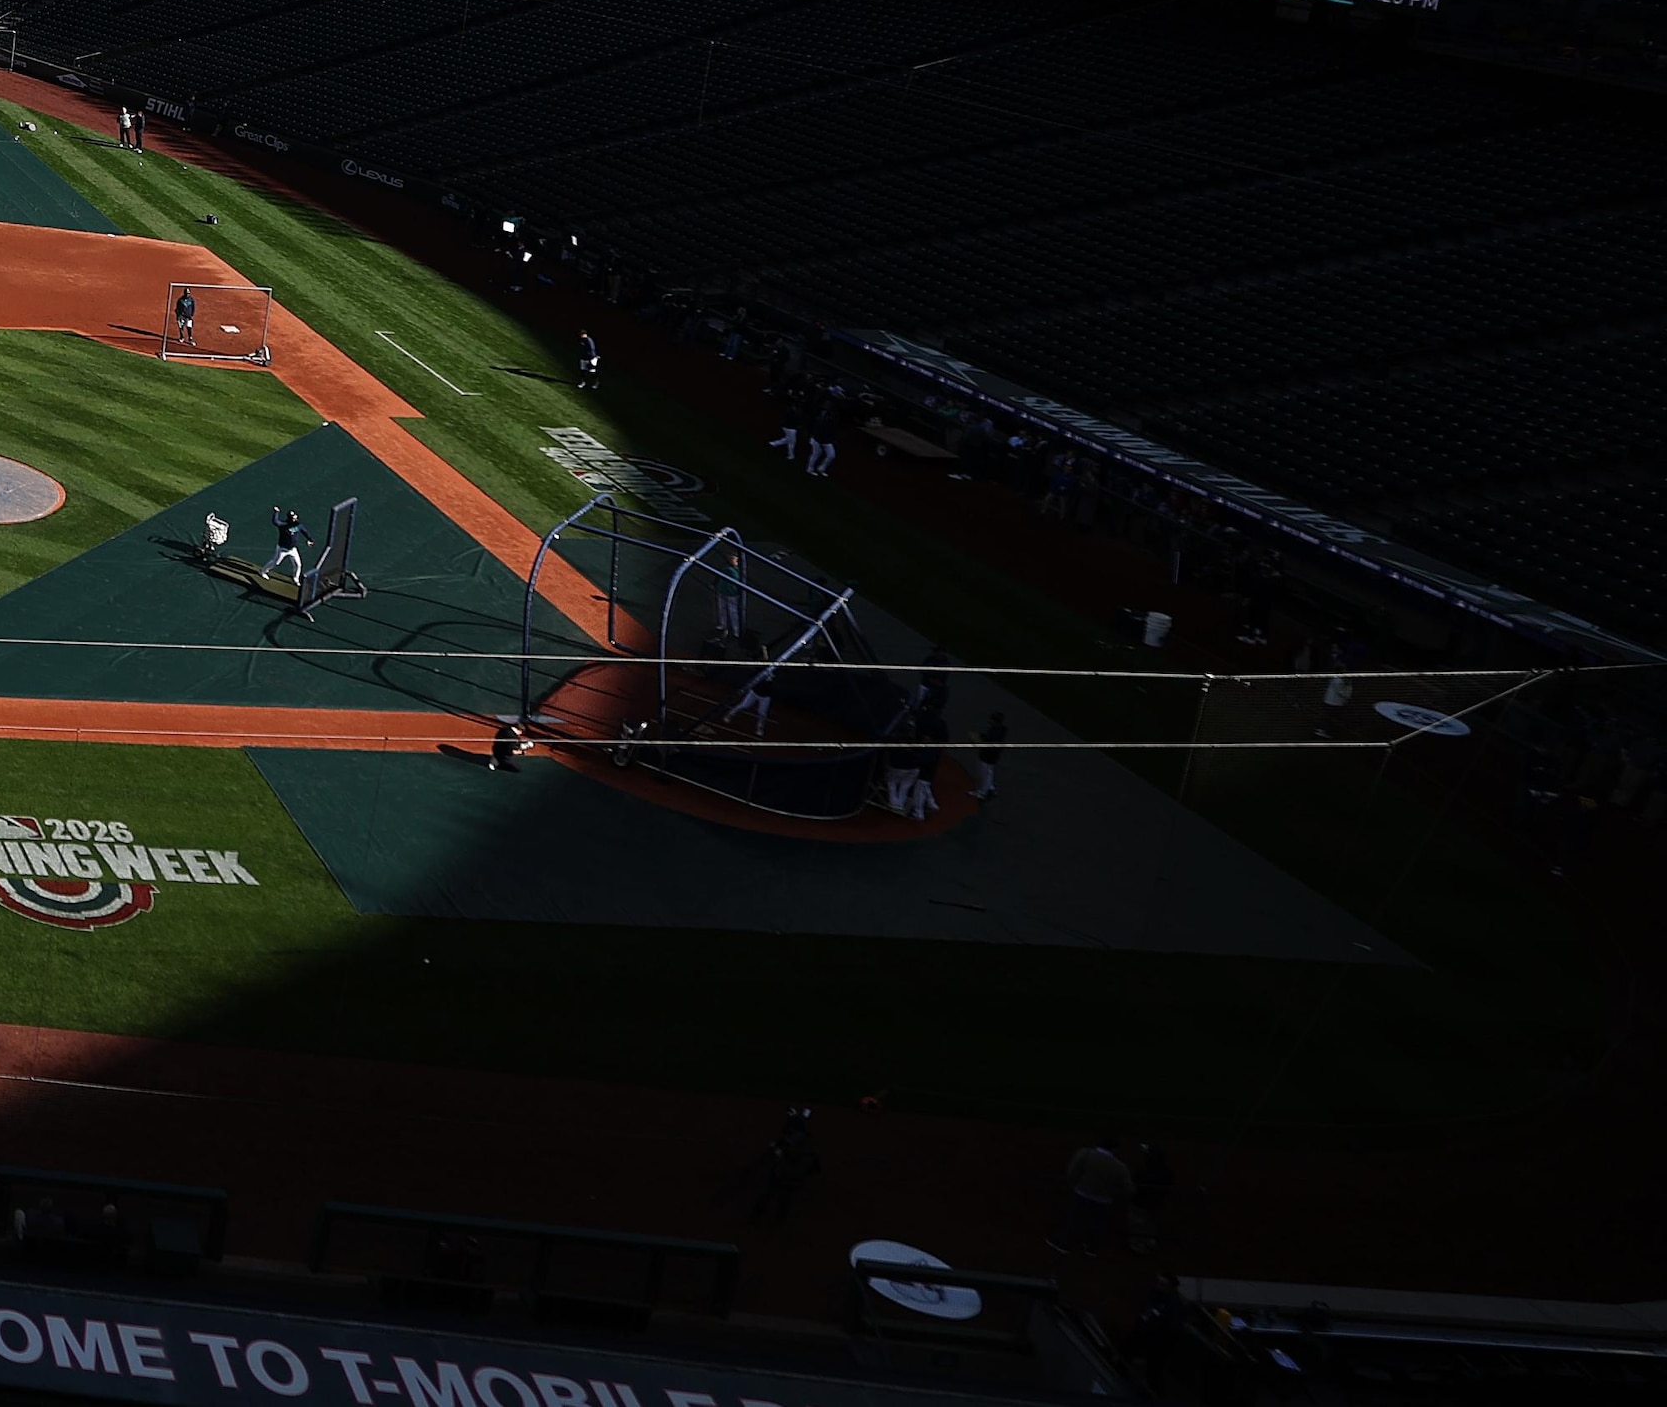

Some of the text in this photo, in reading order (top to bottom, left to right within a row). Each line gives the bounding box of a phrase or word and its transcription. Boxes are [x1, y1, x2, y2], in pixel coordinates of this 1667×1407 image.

[145, 97, 187, 121] STIHL
[234, 125, 289, 153] Great Clips
[358, 168, 405, 189] LEXUS
[44, 818, 134, 844] 2026
[98, 843, 260, 886] WEEK
[188, 1330, 310, 1397] TO
